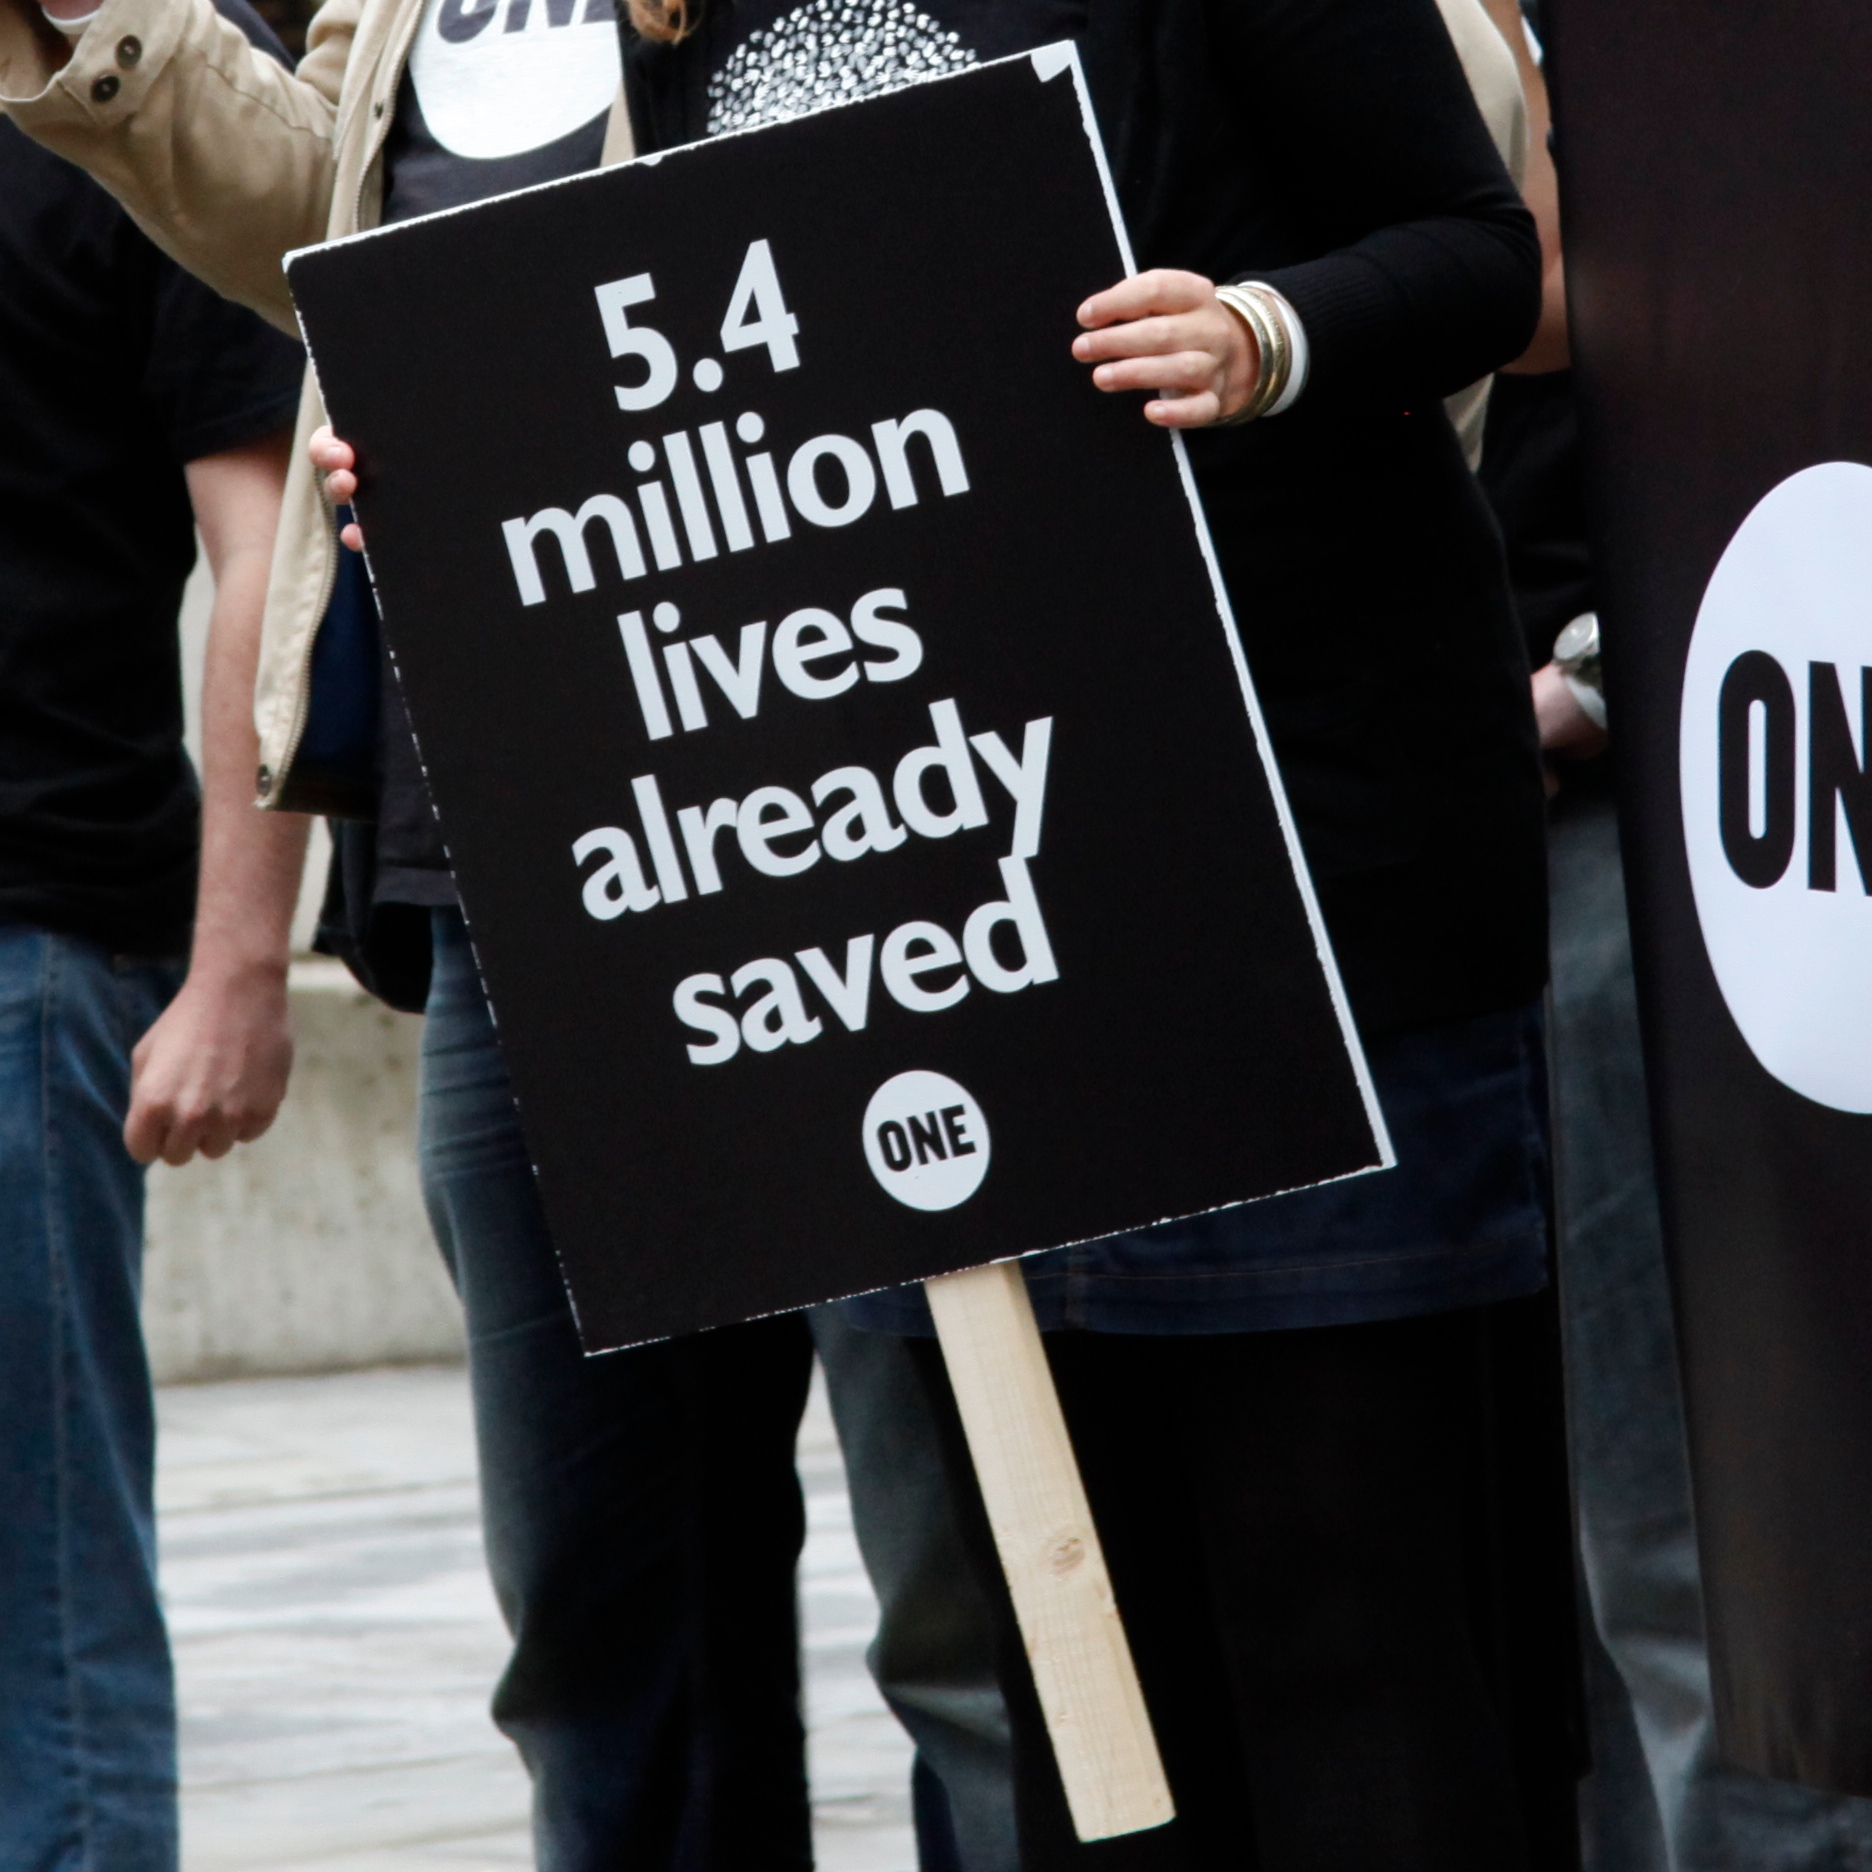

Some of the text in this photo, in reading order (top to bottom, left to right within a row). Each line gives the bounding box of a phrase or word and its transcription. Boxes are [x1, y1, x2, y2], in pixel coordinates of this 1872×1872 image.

[595, 239, 799, 410] 5.4
[502, 409, 969, 605] million
[618, 588, 922, 740] lives
[573, 699, 1052, 920] already
[674, 855, 1058, 1064] saved
[877, 1104, 976, 1172] ONE
